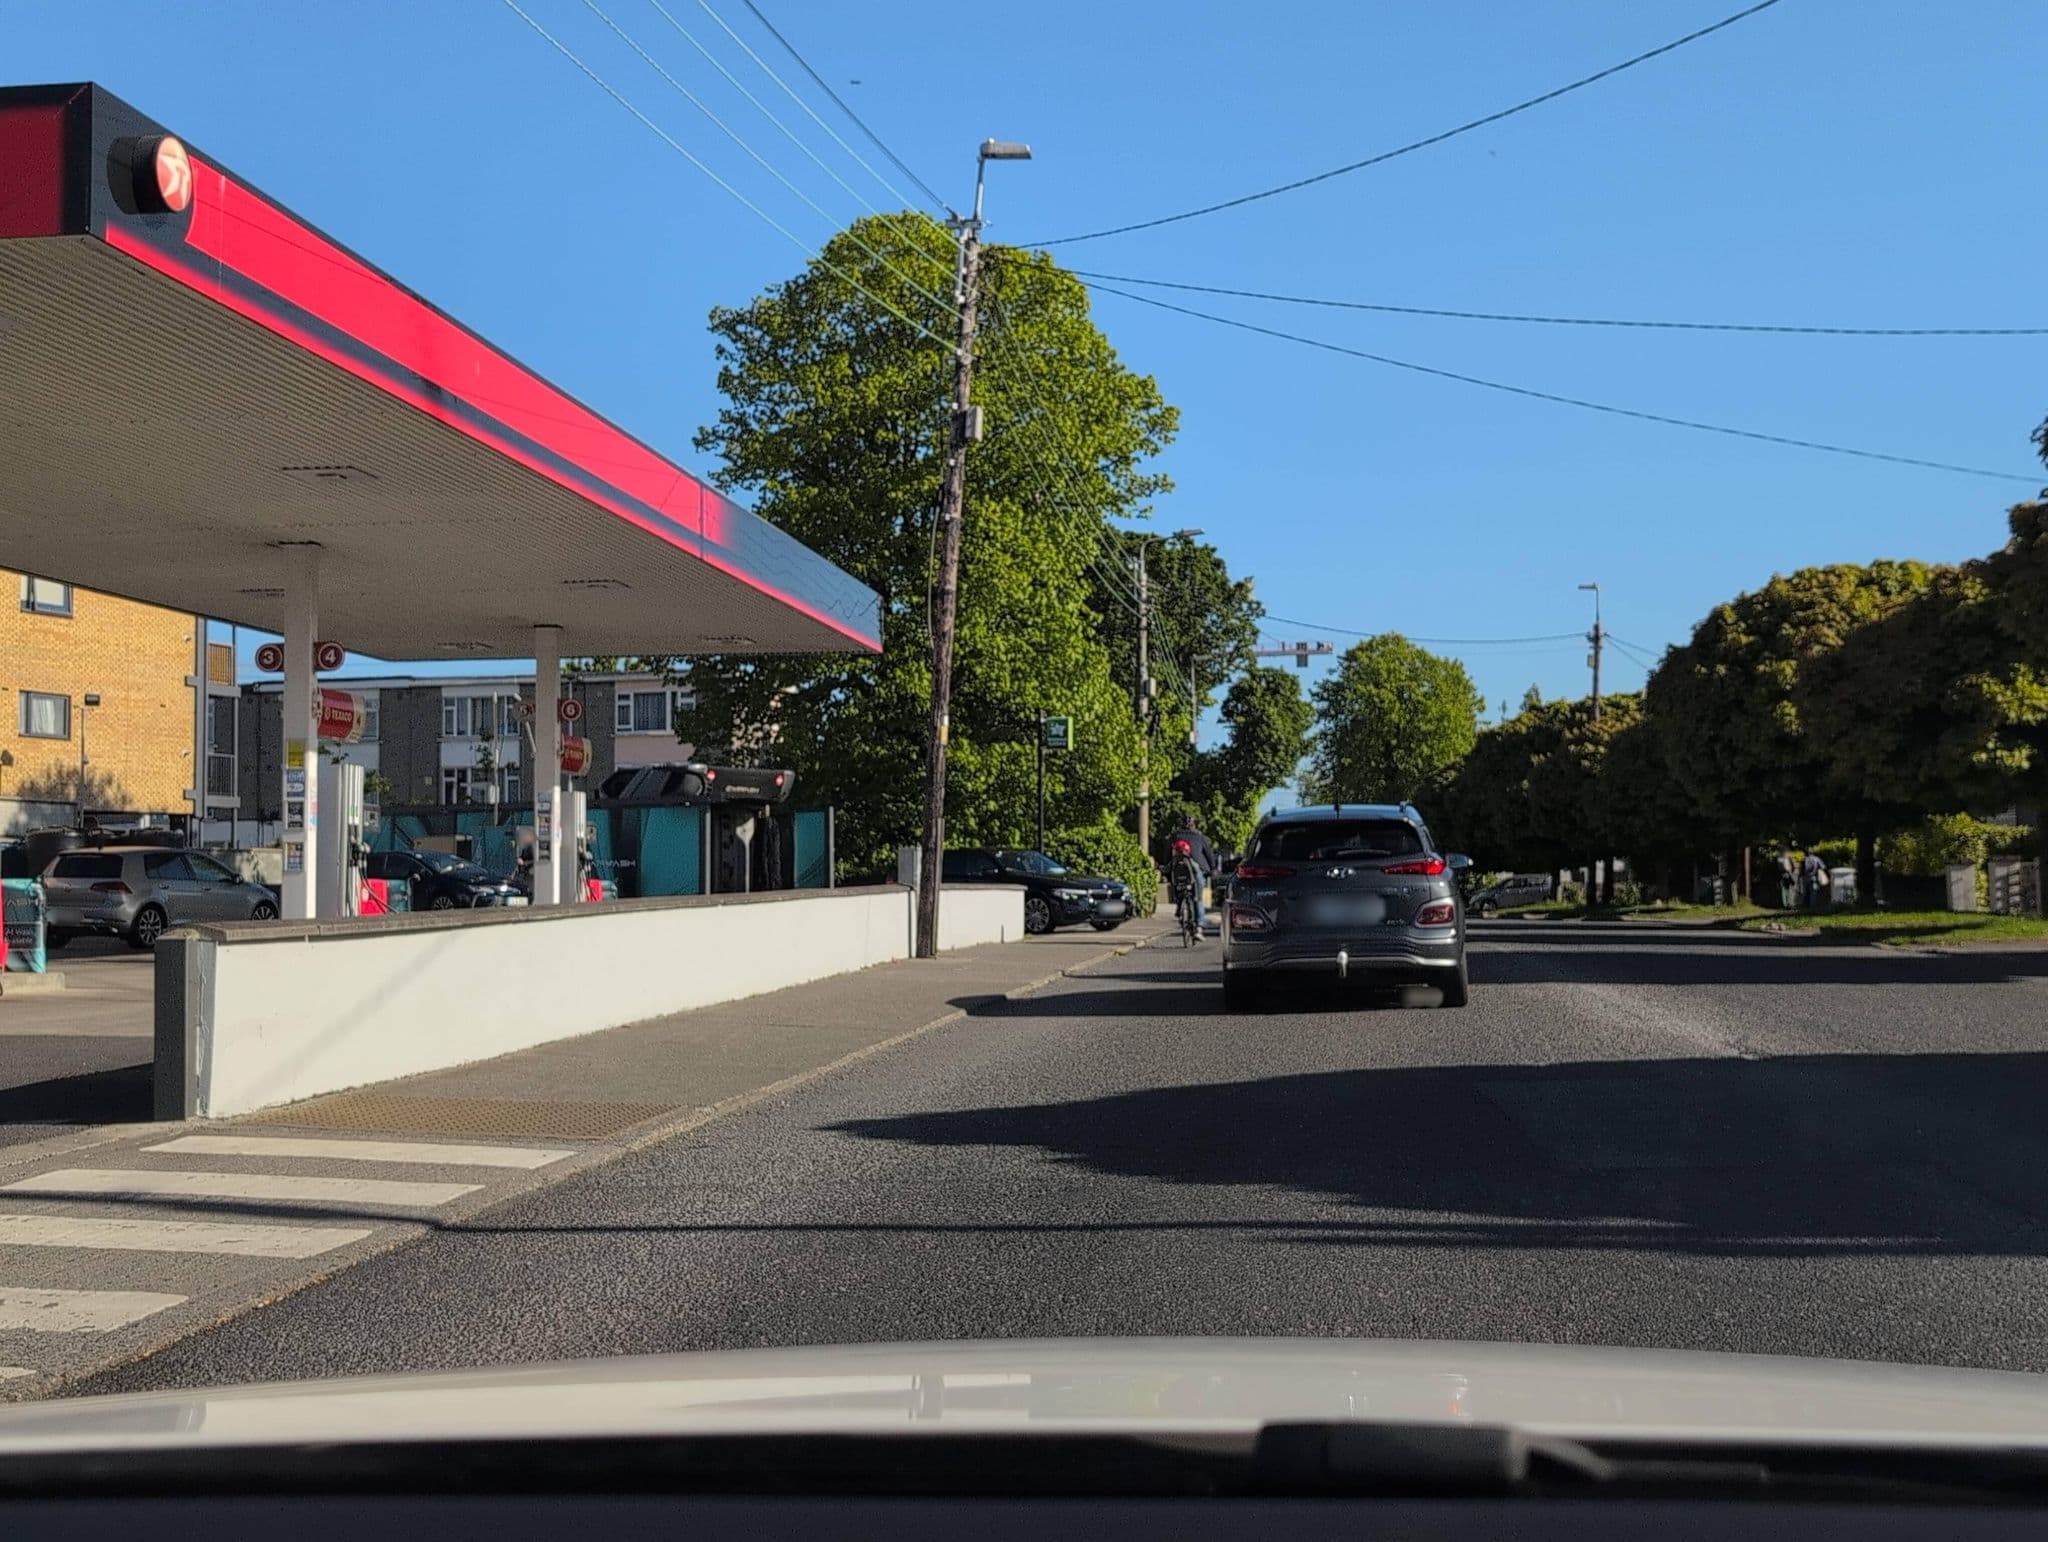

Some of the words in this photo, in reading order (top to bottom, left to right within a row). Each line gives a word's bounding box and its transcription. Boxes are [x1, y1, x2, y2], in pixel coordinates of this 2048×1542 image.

[263, 651, 274, 665] 3
[325, 649, 337, 663] 4
[331, 709, 352, 722] TEXACO
